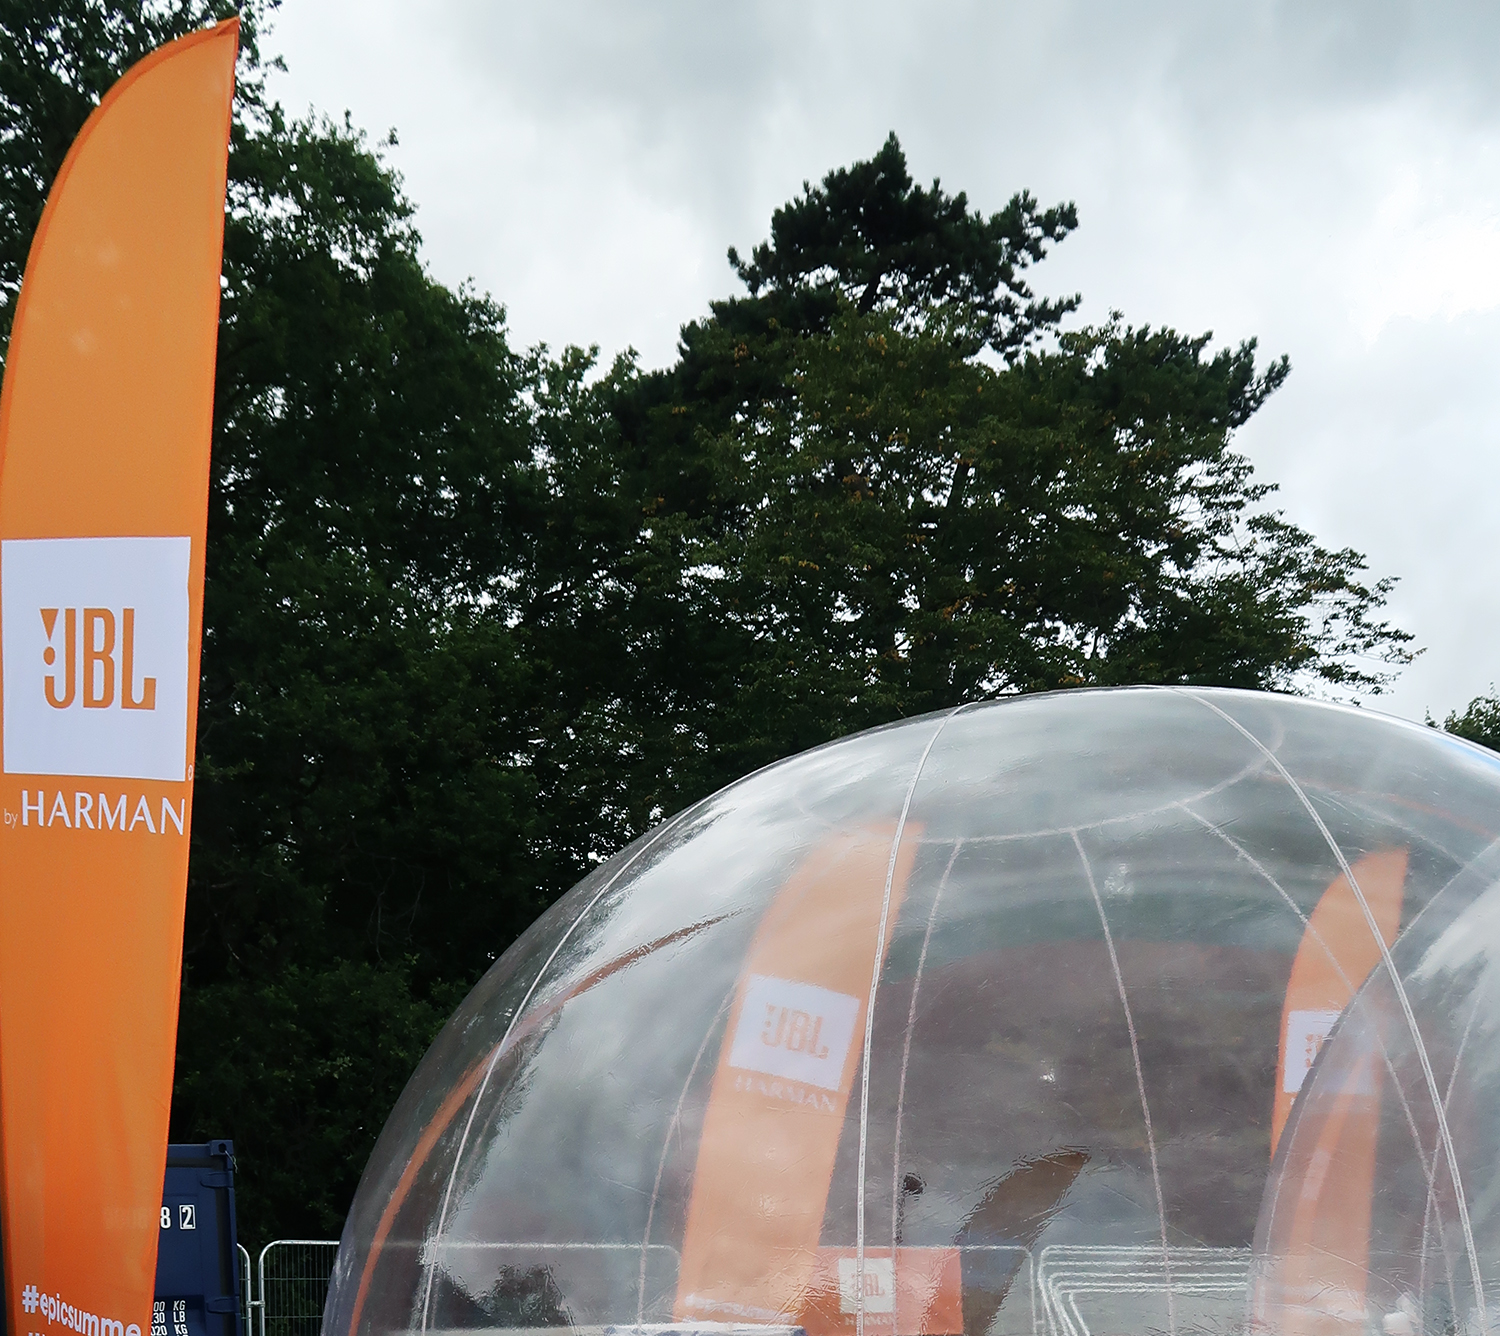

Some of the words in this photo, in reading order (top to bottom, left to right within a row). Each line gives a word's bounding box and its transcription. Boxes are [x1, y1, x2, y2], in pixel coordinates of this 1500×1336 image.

[39, 607, 156, 710] JBL
[4, 809, 18, 825] by
[21, 789, 186, 836] HARMAN
[760, 1002, 829, 1060] JBL
[173, 1300, 186, 1311] KG
[173, 1311, 186, 1323] LB
[174, 1324, 188, 1335] KG
